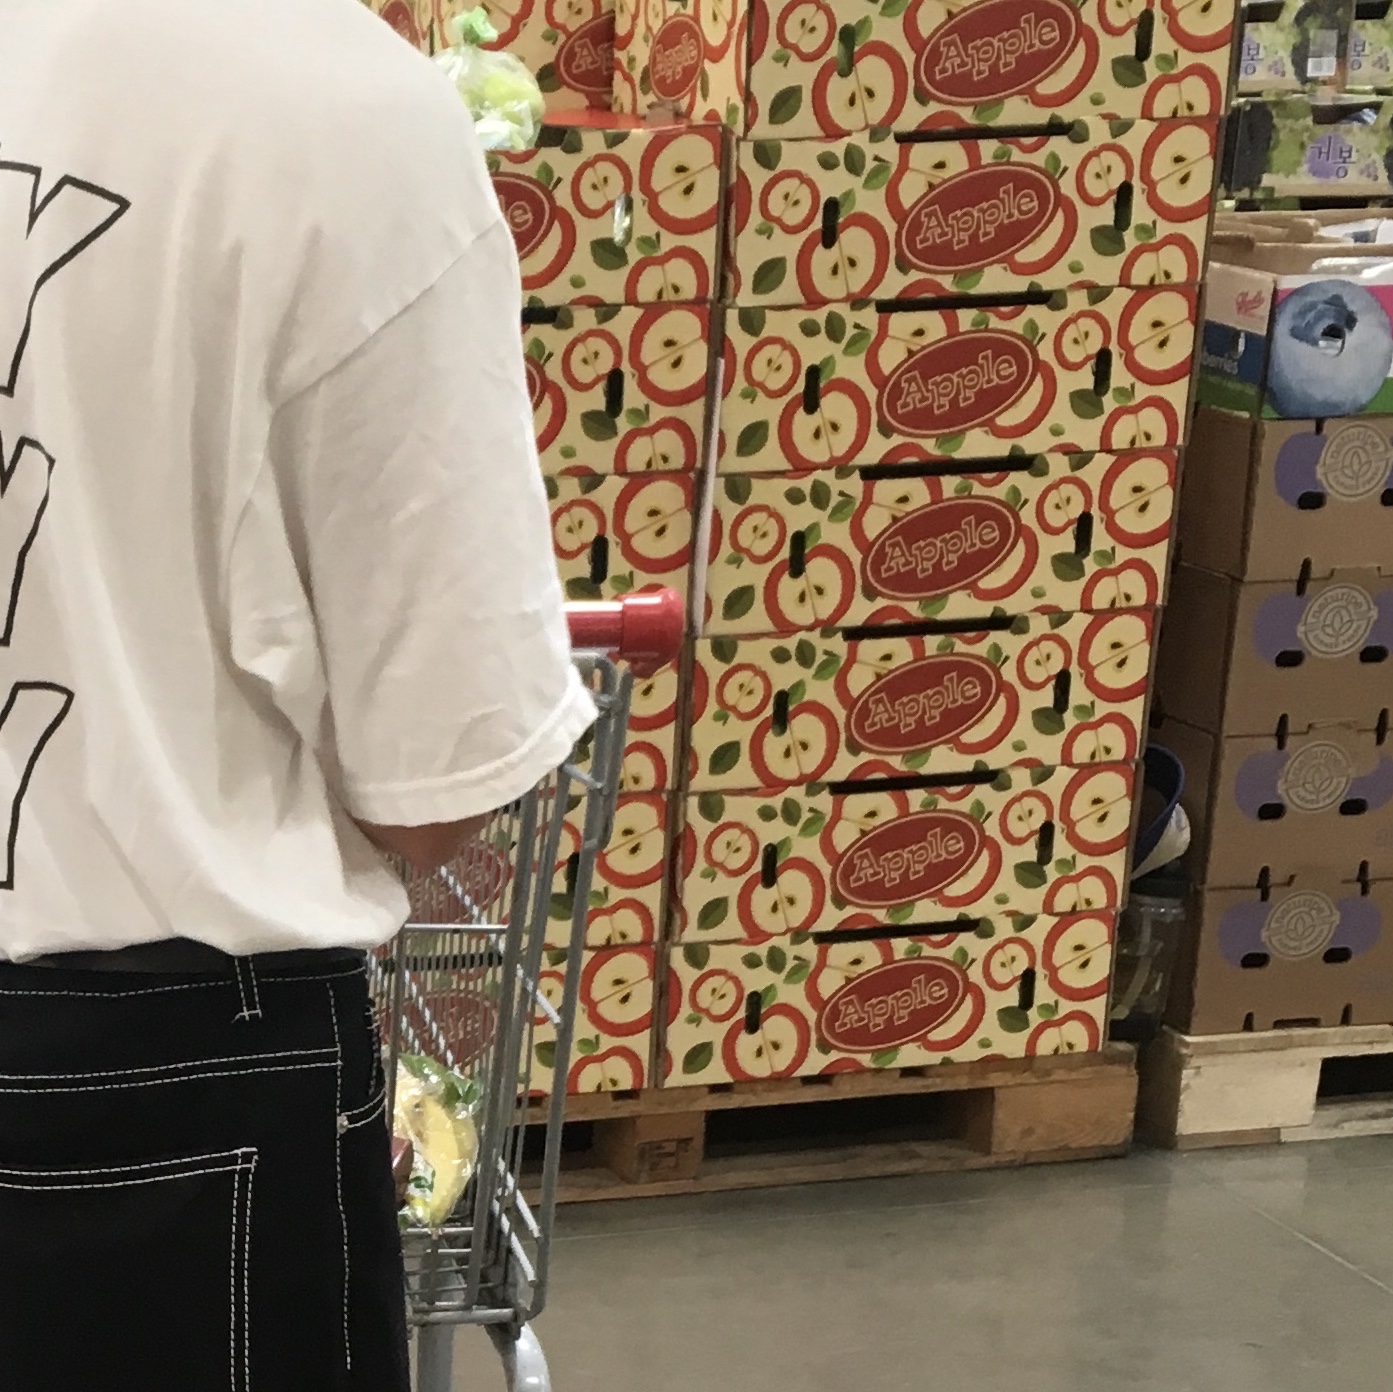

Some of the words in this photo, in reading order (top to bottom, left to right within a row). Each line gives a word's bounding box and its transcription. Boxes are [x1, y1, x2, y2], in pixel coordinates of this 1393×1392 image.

[935, 12, 1060, 81] Apple
[1242, 42, 1263, 75] 봉
[1349, 42, 1370, 71] 봉
[1310, 135, 1357, 179] 거봉
[916, 182, 1039, 250] Apple
[897, 350, 1018, 414] Apple
[880, 515, 1000, 578] Apple
[864, 671, 981, 733] Apple
[850, 827, 964, 888] Apple
[835, 974, 948, 1033] Apple
